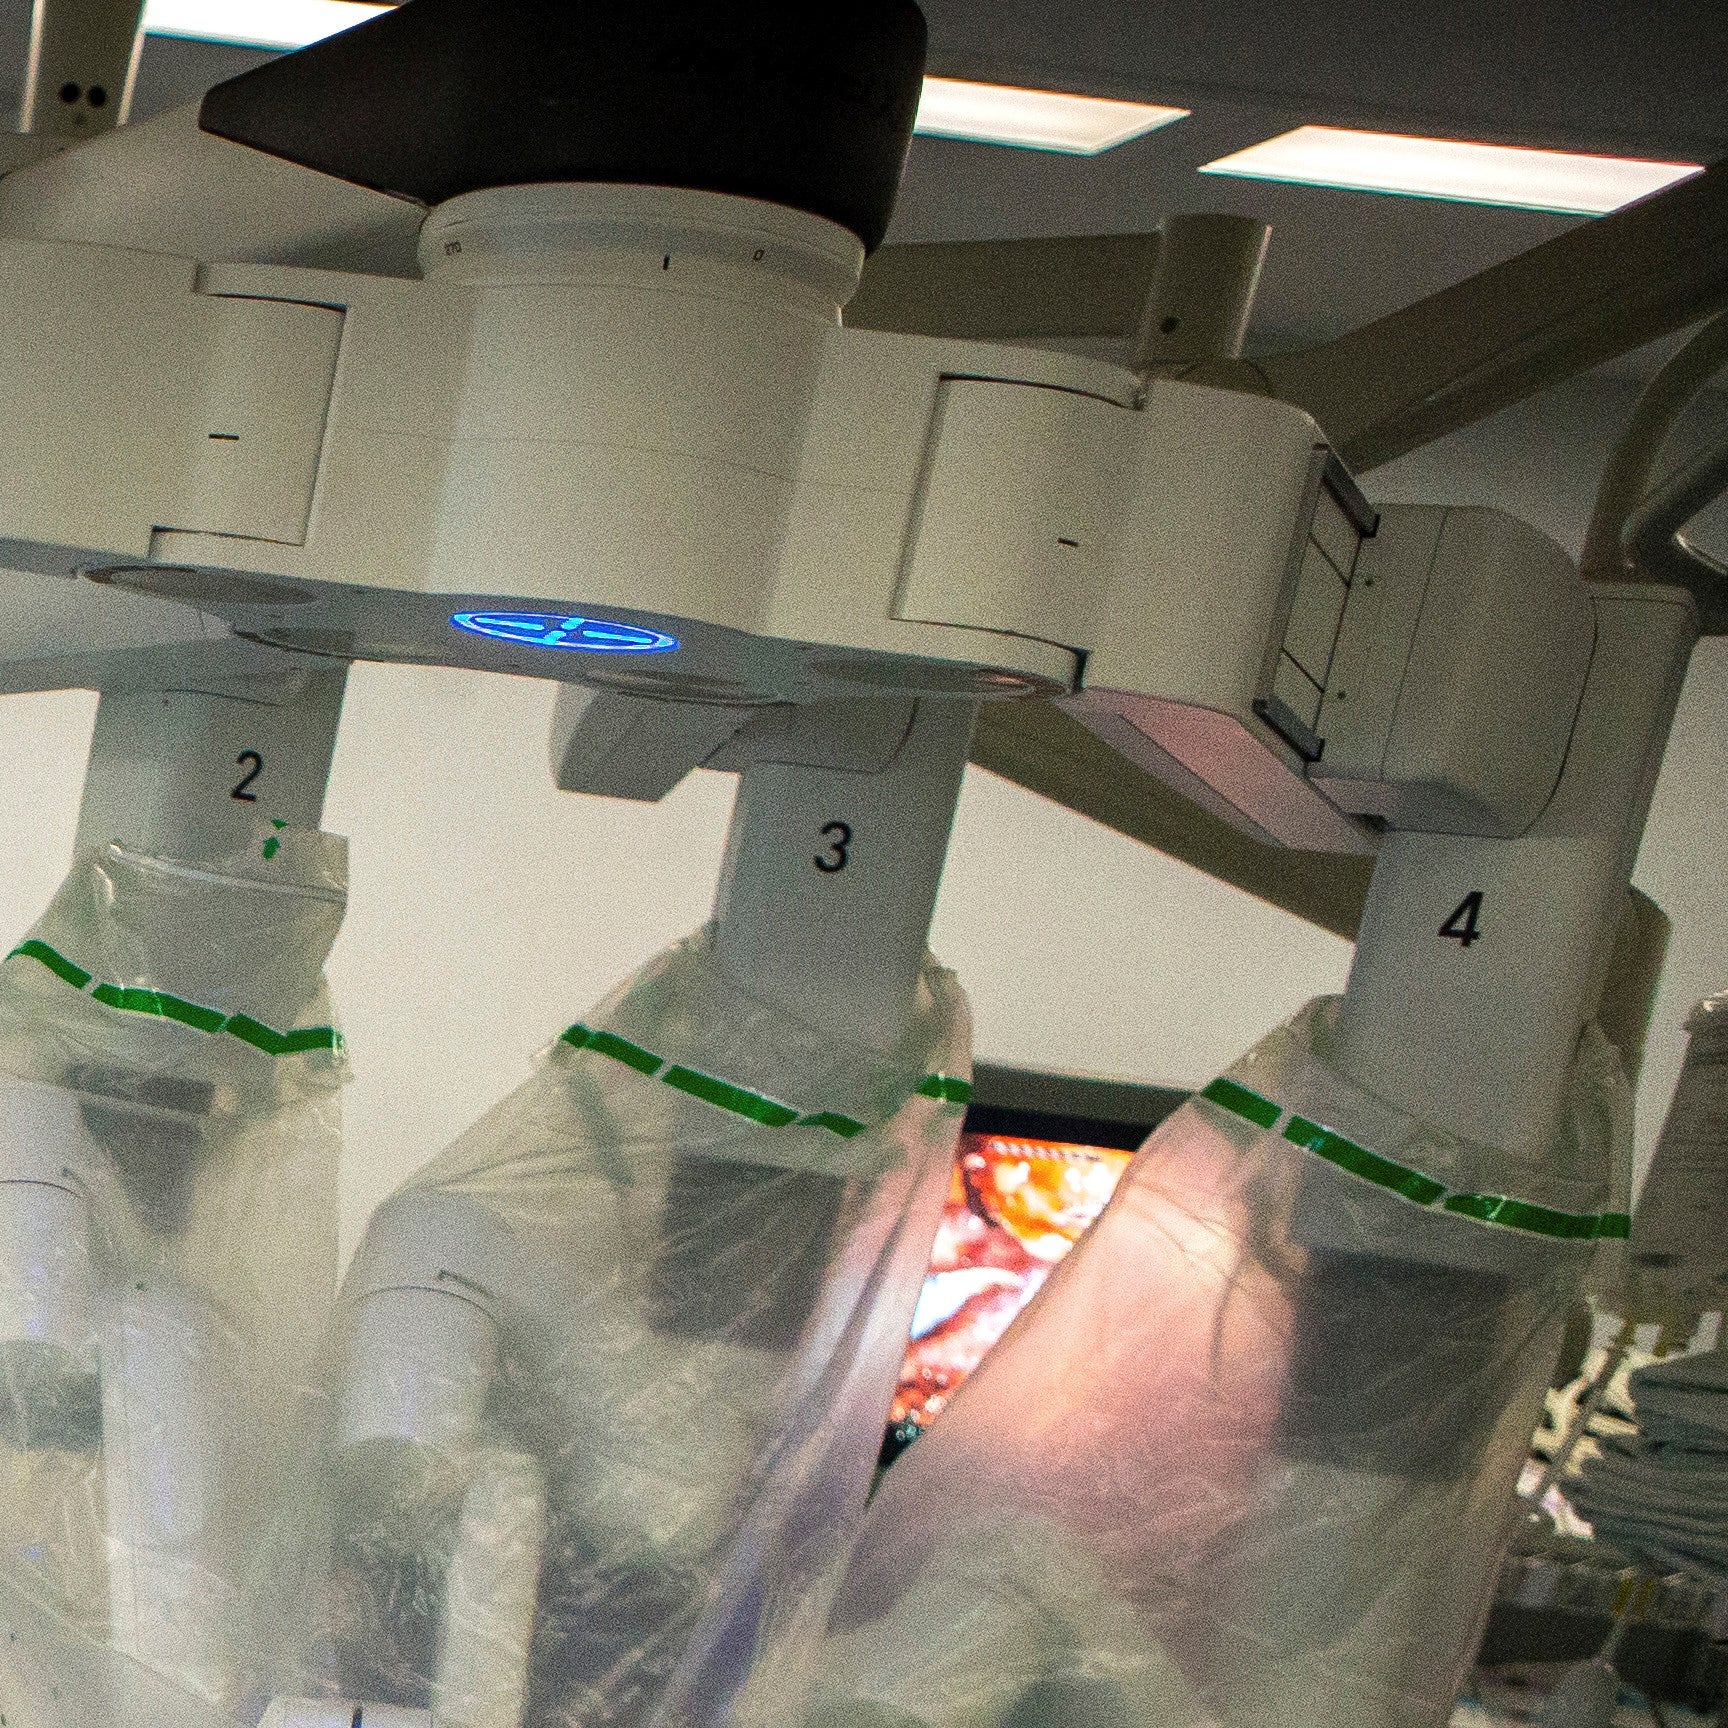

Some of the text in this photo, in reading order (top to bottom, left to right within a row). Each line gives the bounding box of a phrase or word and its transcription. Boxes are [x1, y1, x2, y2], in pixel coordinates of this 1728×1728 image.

[230, 750, 265, 803] 2
[814, 821, 852, 874] 3
[1438, 891, 1484, 948] 4
